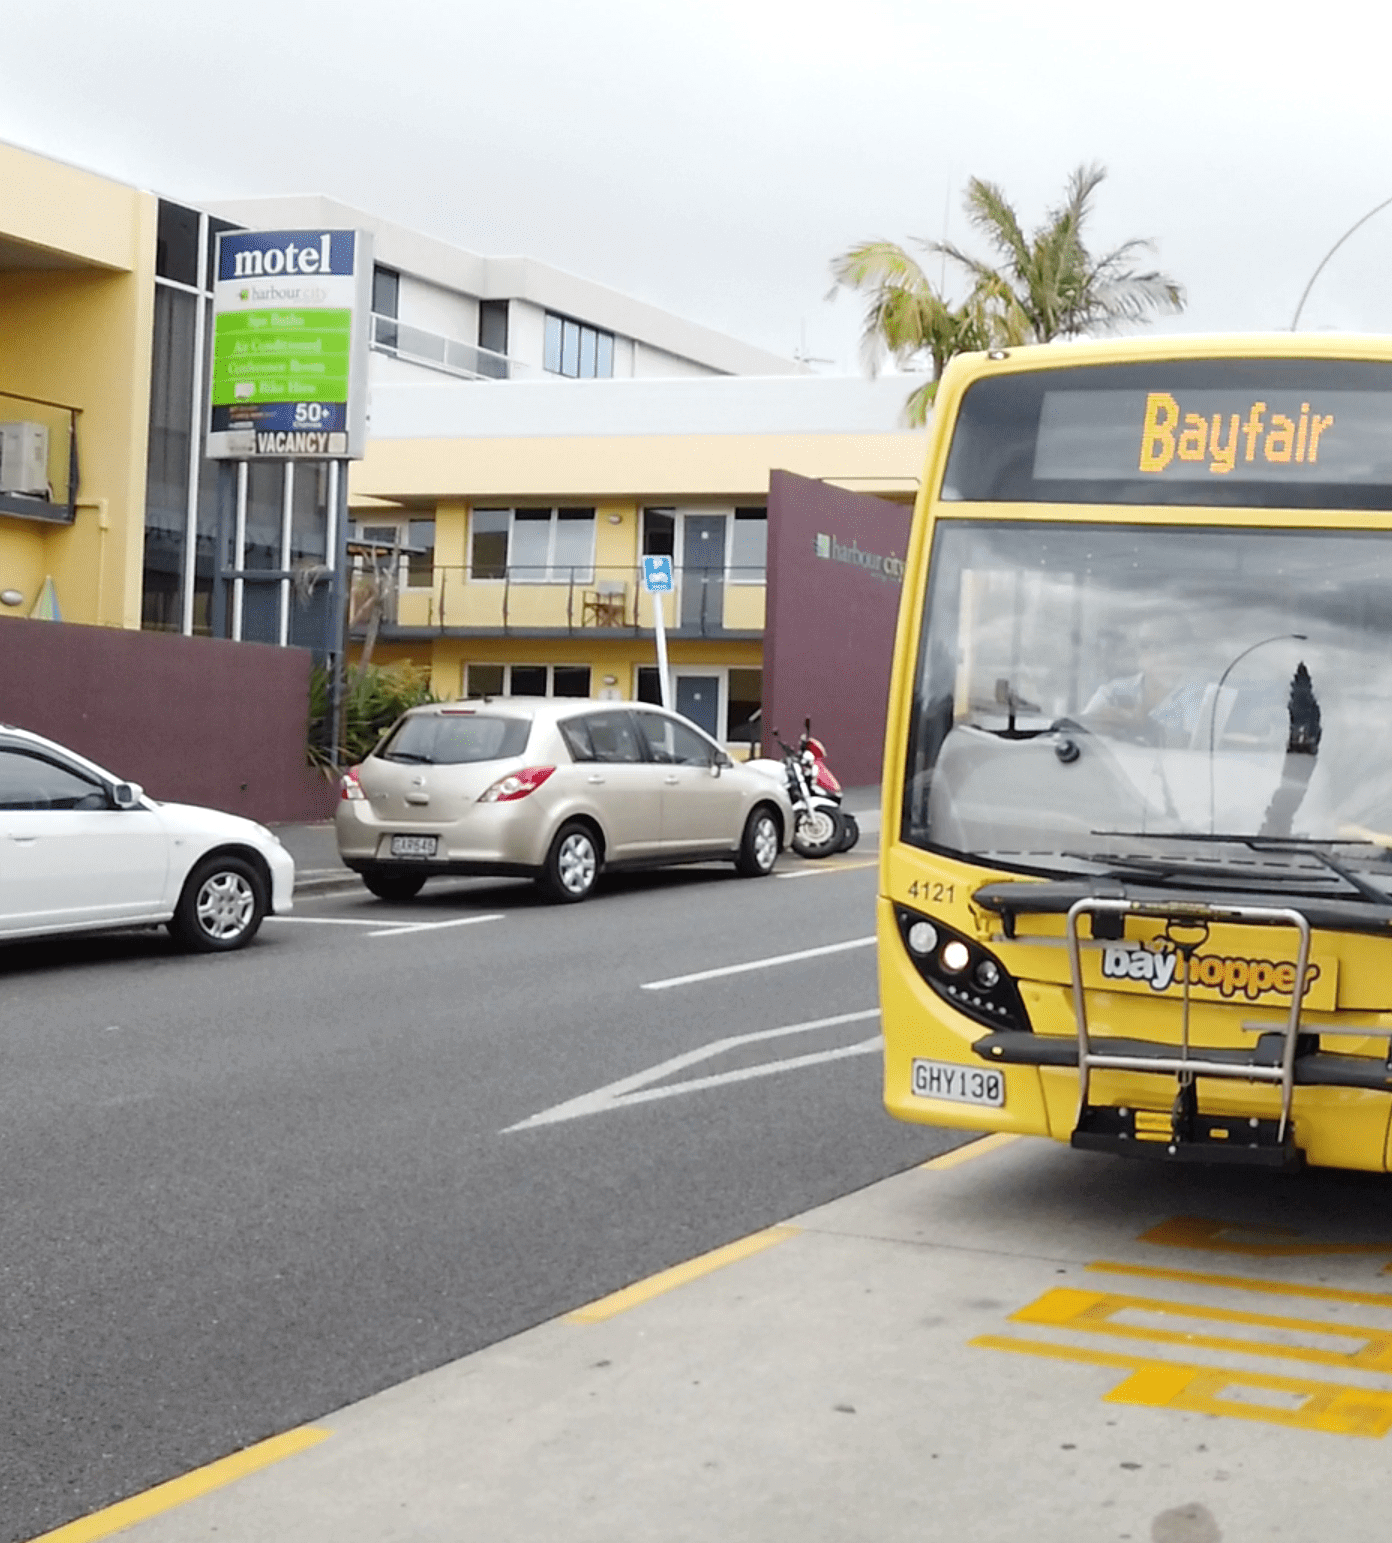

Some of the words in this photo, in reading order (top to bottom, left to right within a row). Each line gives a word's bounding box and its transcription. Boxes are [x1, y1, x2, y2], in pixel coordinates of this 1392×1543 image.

[234, 233, 331, 276] motel
[252, 285, 301, 300] harbour
[303, 287, 327, 302] city
[258, 432, 328, 453] VACANCY
[1139, 392, 1334, 473] Bayfair
[833, 534, 882, 571] harbour
[907, 880, 955, 904] 4121
[916, 1065, 999, 1100] GHY130
